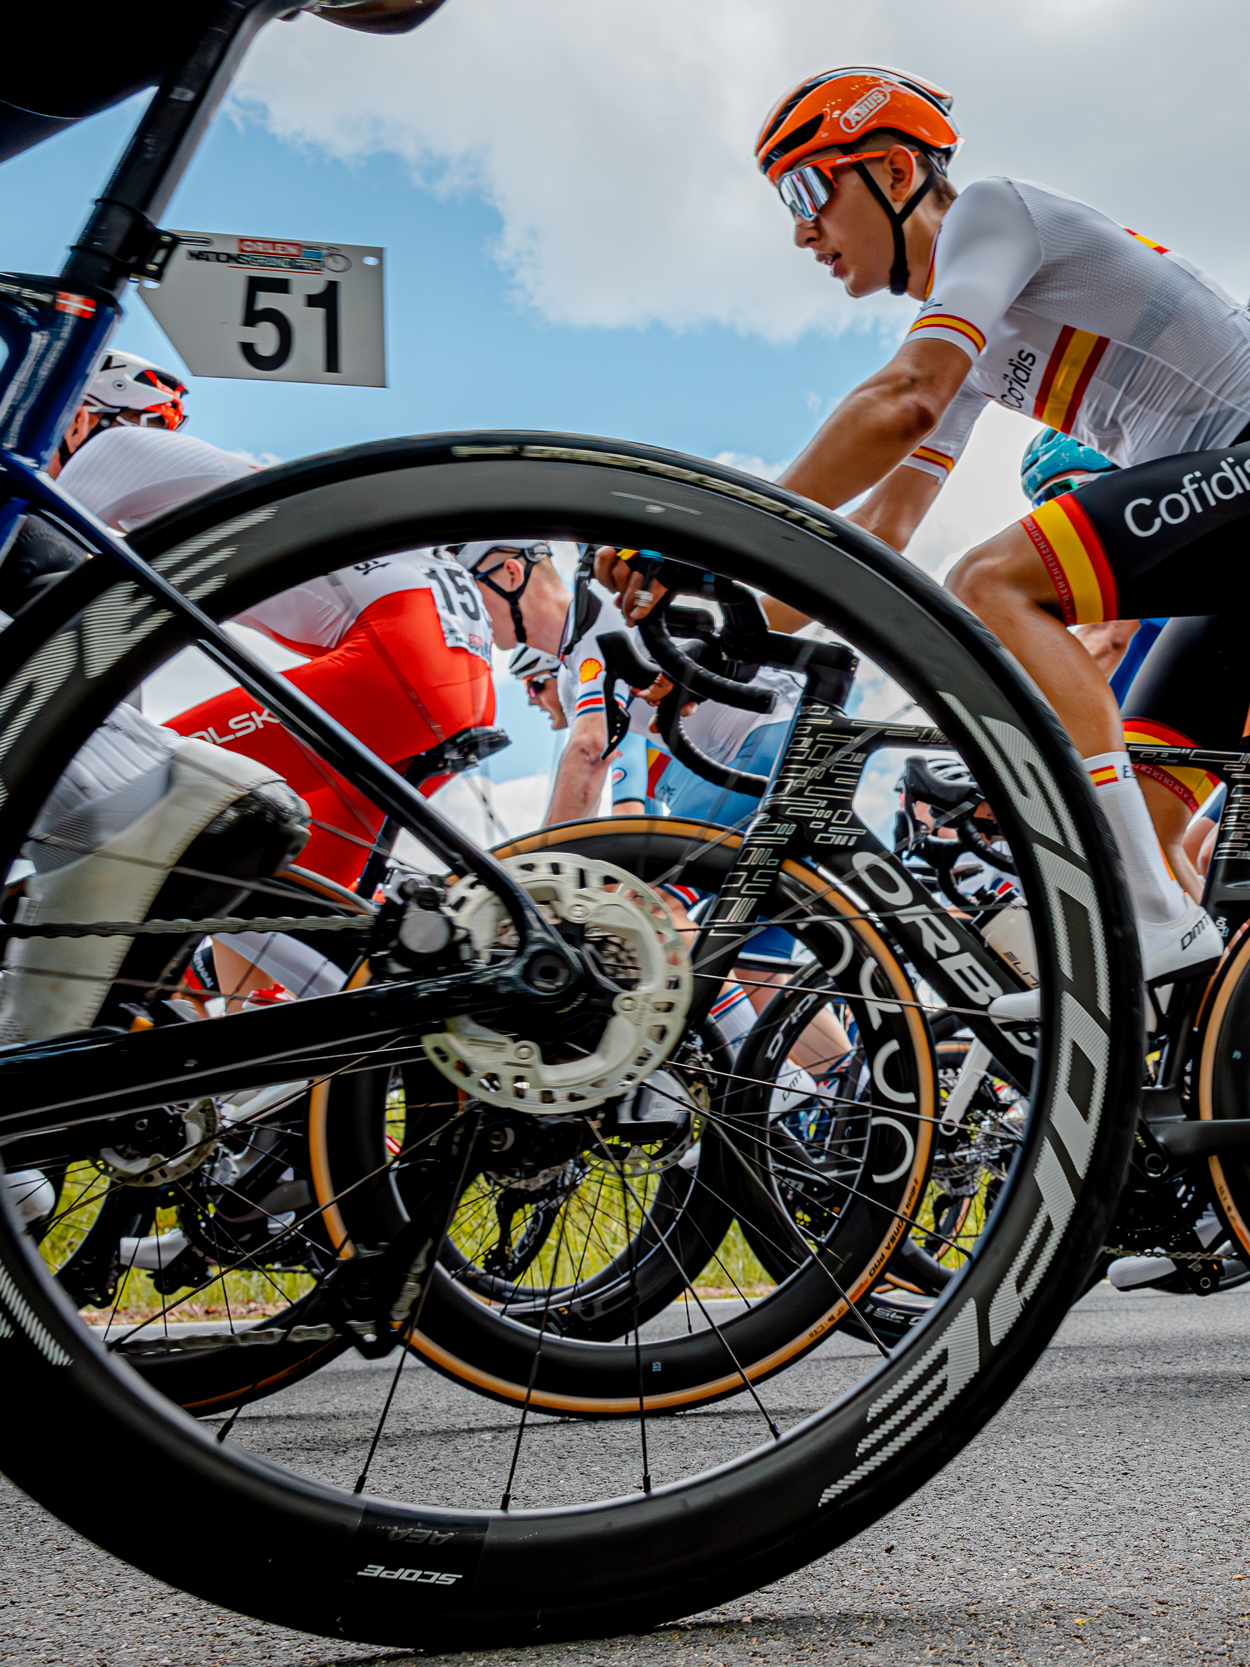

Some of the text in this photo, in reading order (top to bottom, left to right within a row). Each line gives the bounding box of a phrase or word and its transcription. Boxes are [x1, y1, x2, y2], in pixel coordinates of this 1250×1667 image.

[846, 91, 886, 127] ABUS
[237, 275, 342, 374] 51
[1002, 950, 1041, 988] ELIT
[356, 1563, 464, 1587] SCOPE
